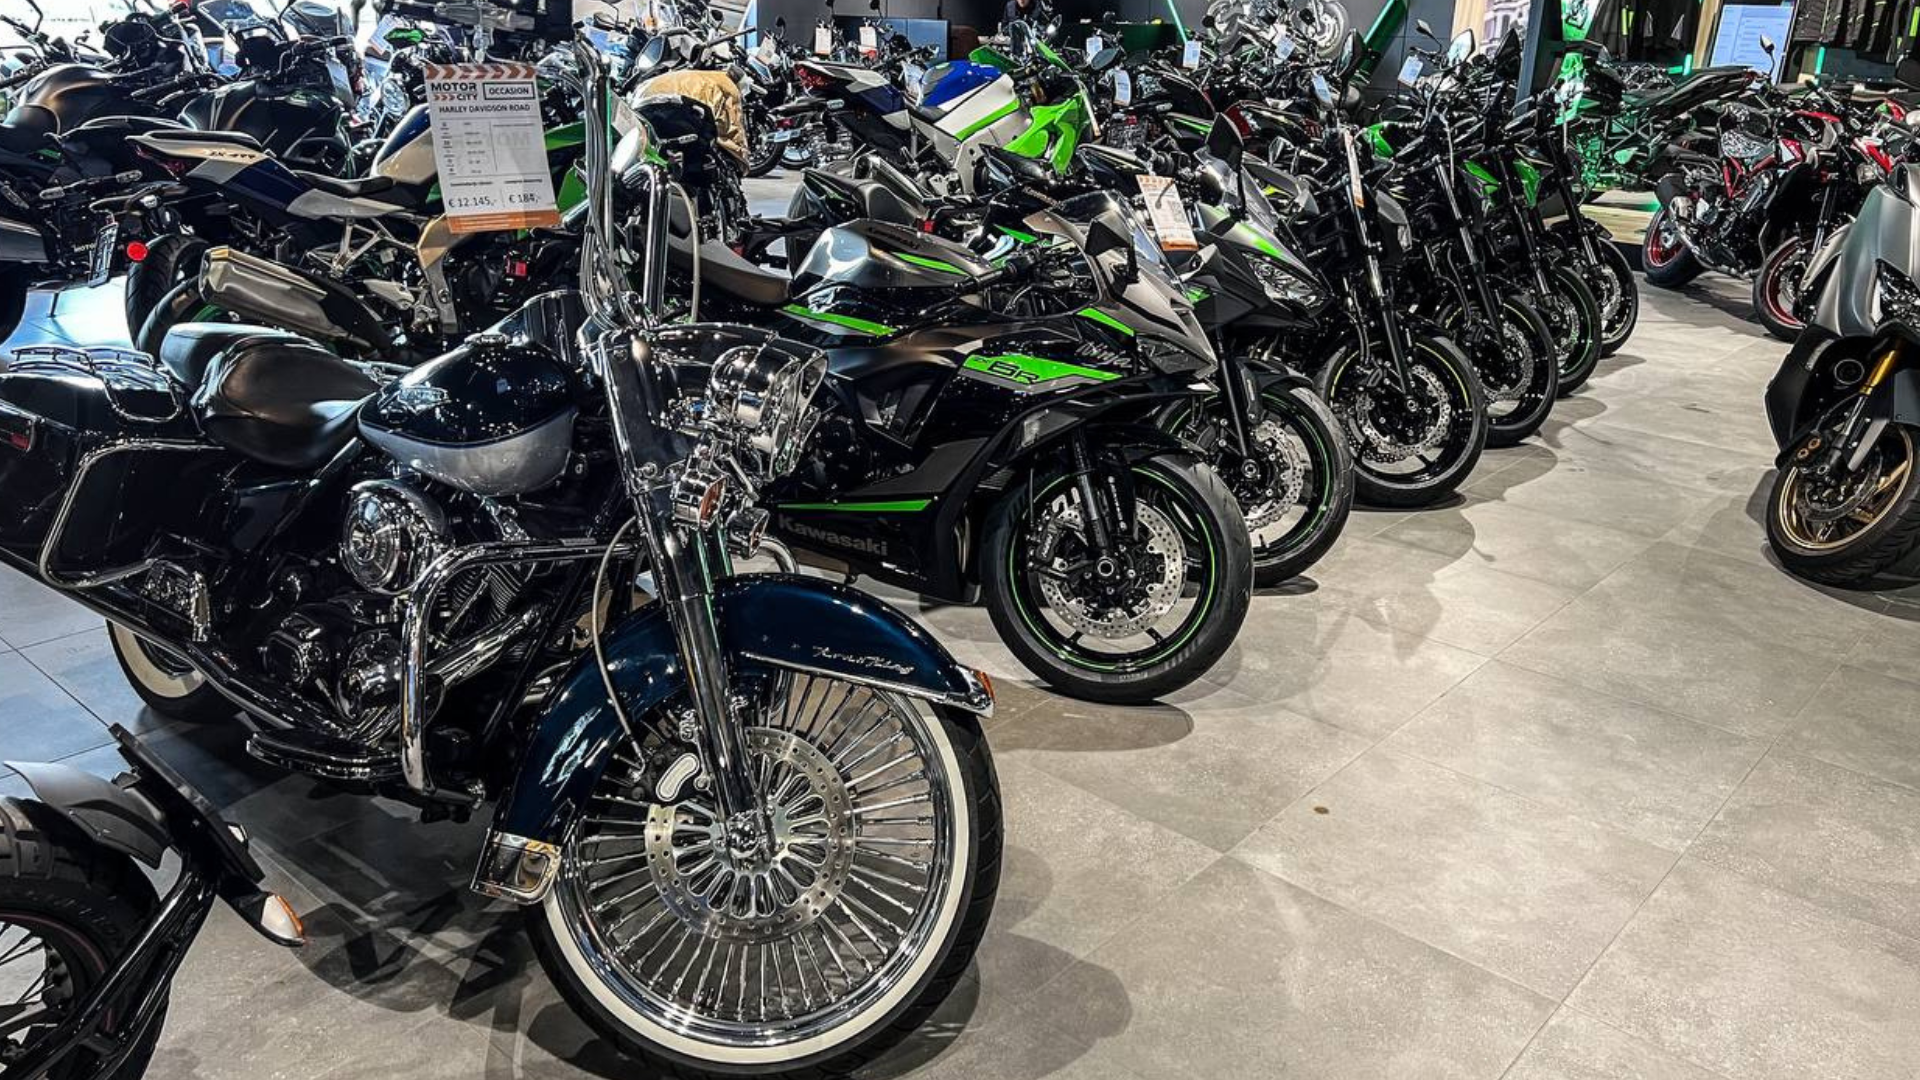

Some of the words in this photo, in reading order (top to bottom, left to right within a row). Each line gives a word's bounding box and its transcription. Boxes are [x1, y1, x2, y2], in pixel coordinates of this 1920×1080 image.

[431, 82, 477, 91] MOTOR
[488, 87, 529, 95] OCCASION
[778, 514, 888, 556] Kawasaki
